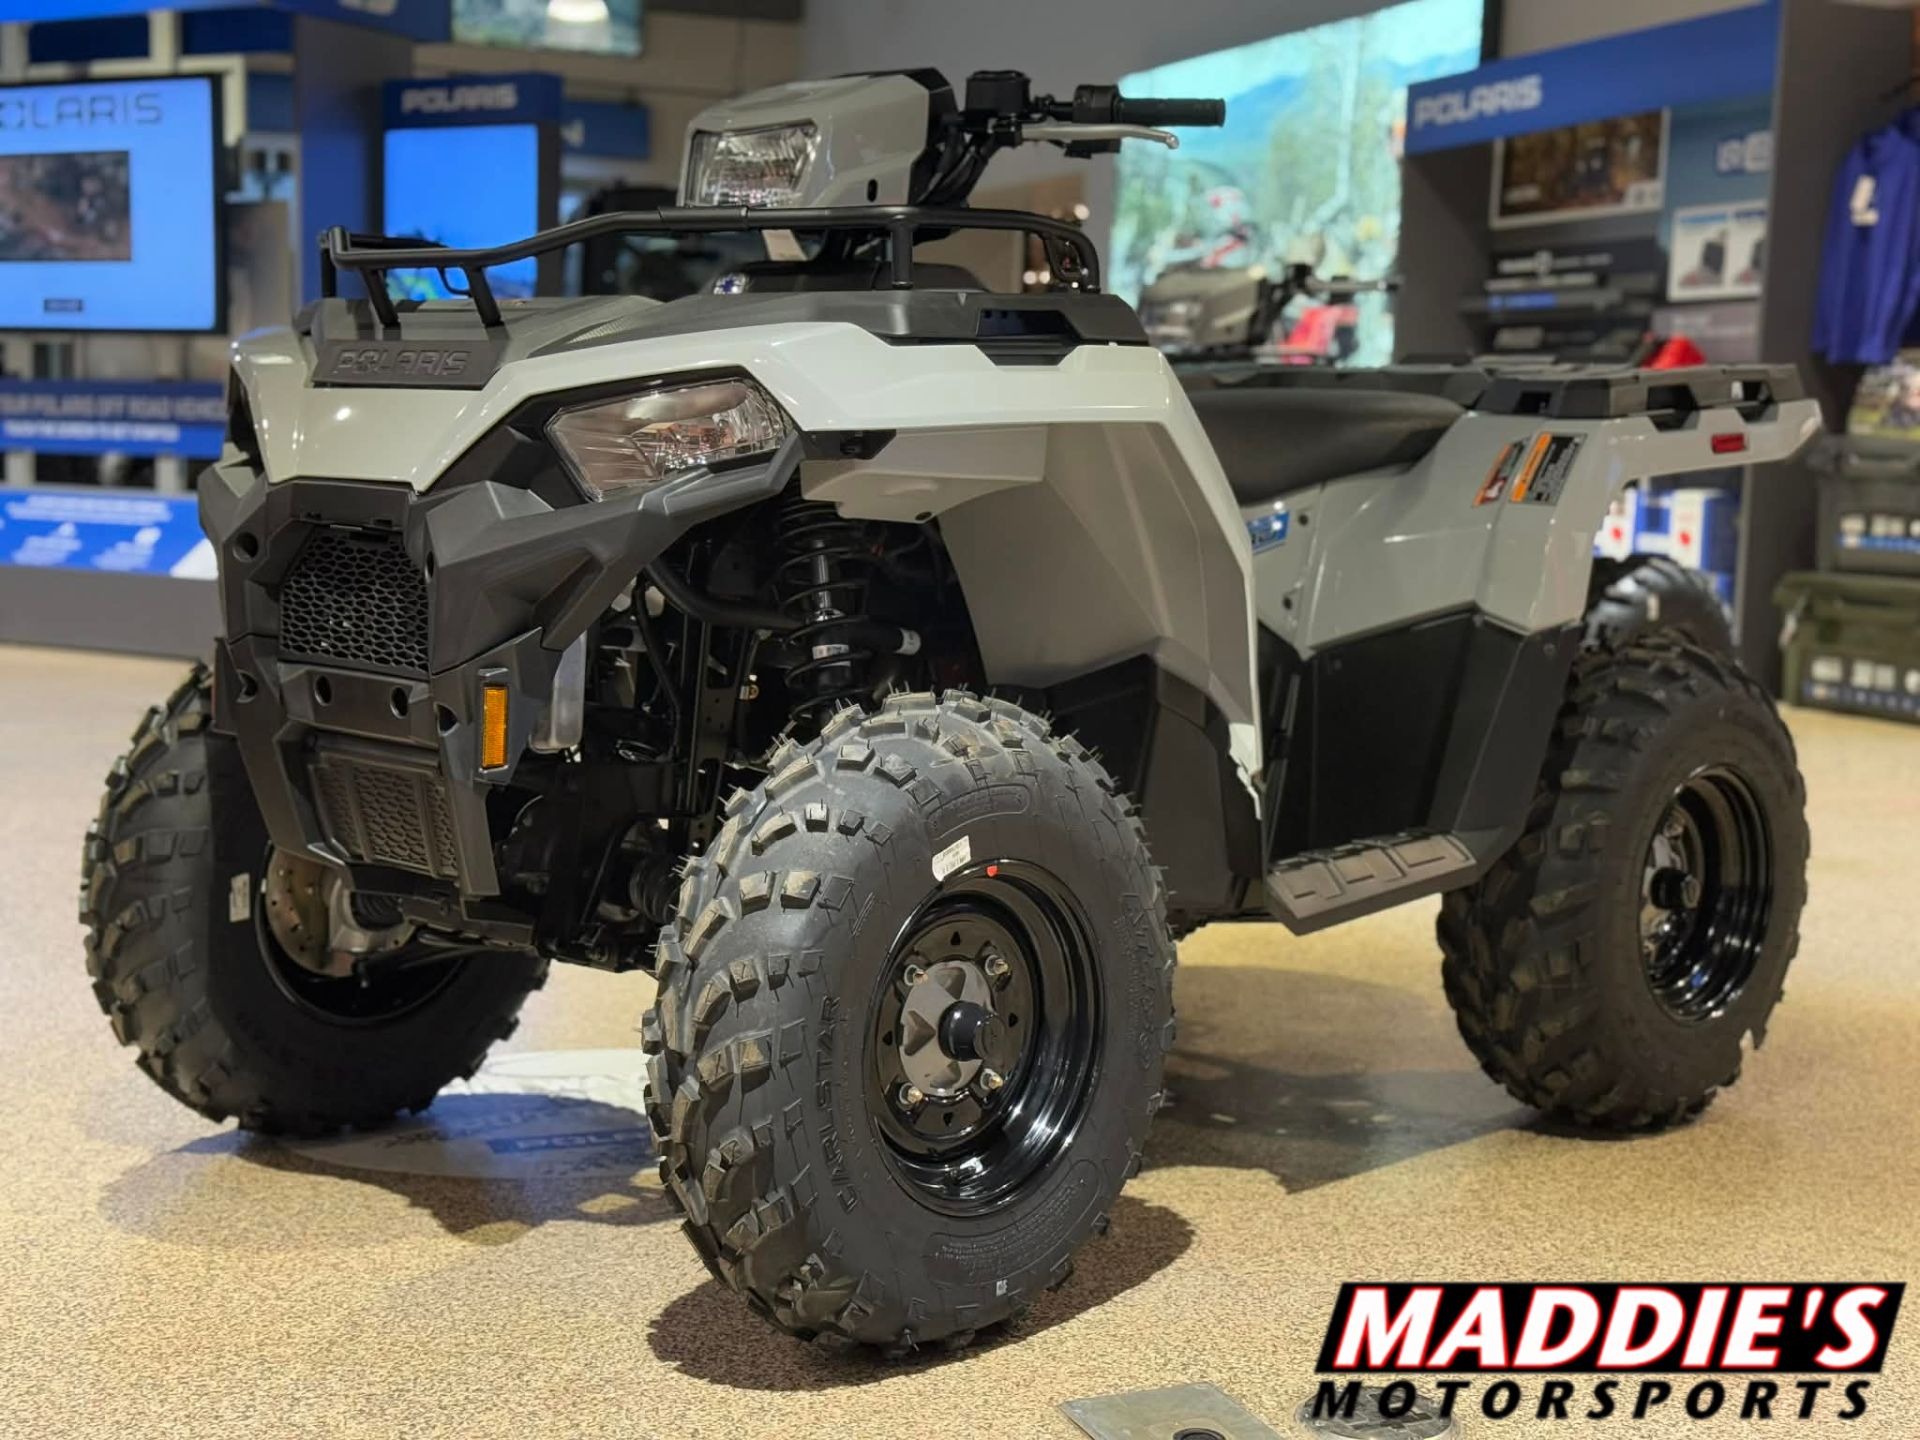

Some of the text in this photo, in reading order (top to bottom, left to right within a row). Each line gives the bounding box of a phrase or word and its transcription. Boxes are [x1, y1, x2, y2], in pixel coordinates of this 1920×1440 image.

[401, 83, 518, 114] POLARIS
[1413, 74, 1543, 129] POLARIS
[335, 349, 472, 377] POLARIS
